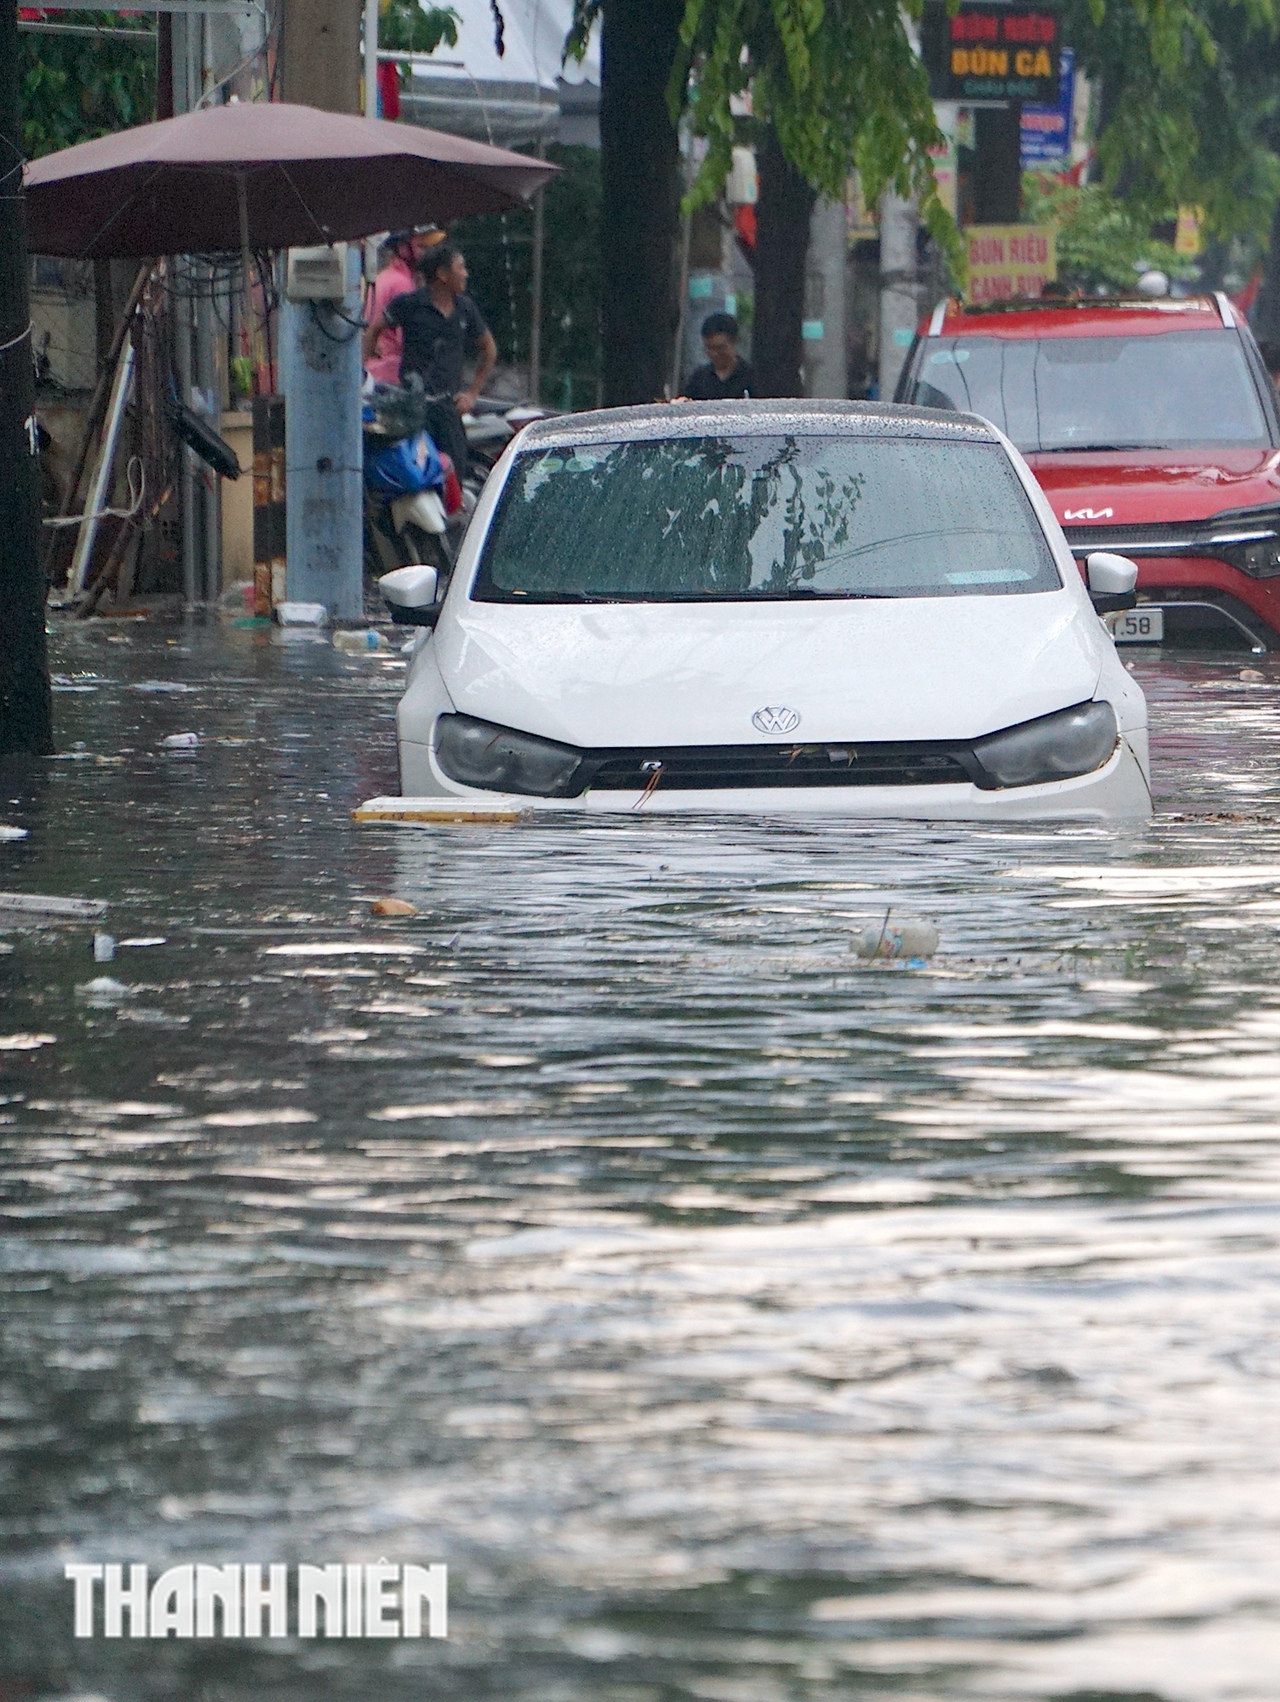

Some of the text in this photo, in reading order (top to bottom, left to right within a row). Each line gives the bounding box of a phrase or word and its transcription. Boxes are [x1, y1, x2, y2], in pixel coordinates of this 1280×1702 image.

[950, 45, 1051, 77] BÚN CÁ
[970, 234, 1004, 265] BÚN
